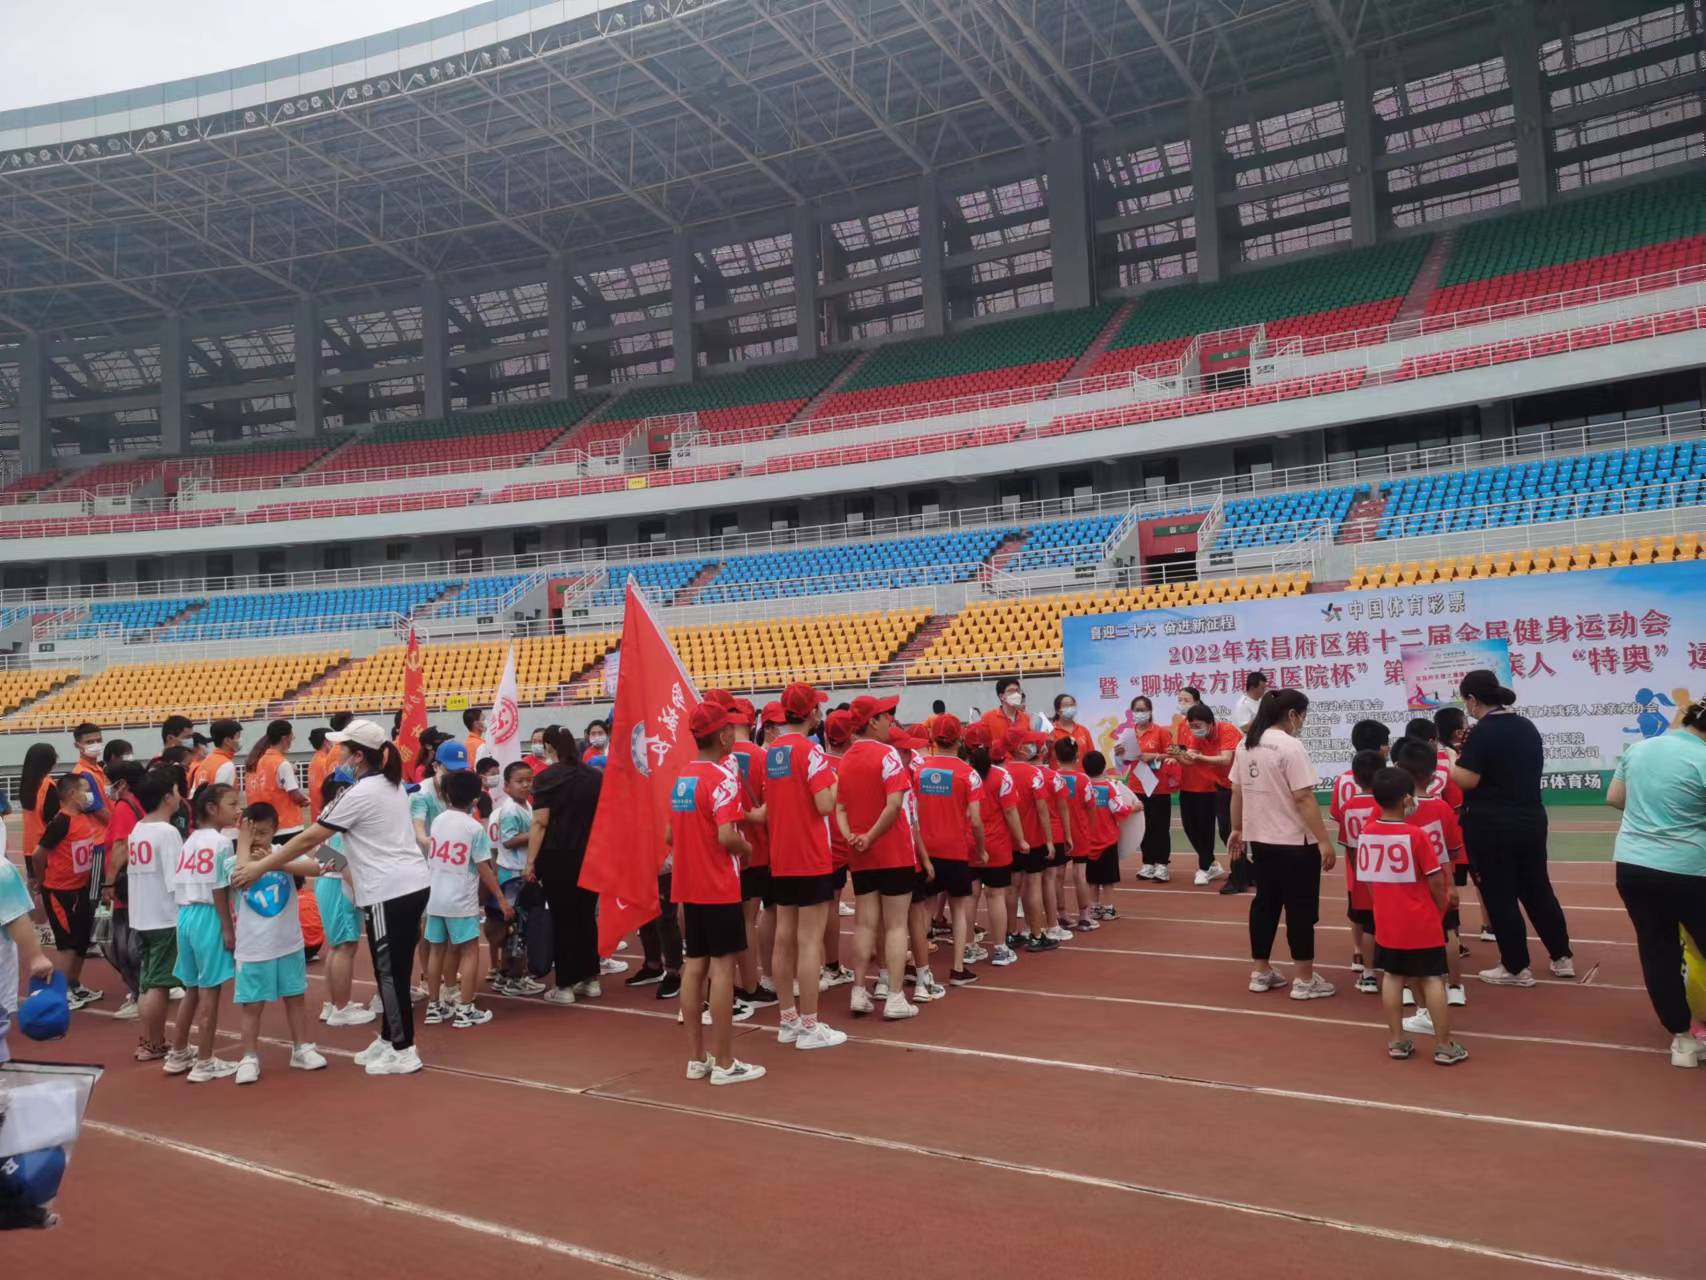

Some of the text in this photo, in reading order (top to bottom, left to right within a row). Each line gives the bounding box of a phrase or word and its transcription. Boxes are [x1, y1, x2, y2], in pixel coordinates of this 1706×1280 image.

[1348, 590, 1466, 621] 中国体育彩票
[1090, 614, 1236, 641] 喜迎二十大 奋进新征程
[1099, 676, 1119, 699] 暨
[1572, 644, 1669, 675] “特奥”
[1358, 840, 1410, 873] 079
[254, 883, 280, 908] 17
